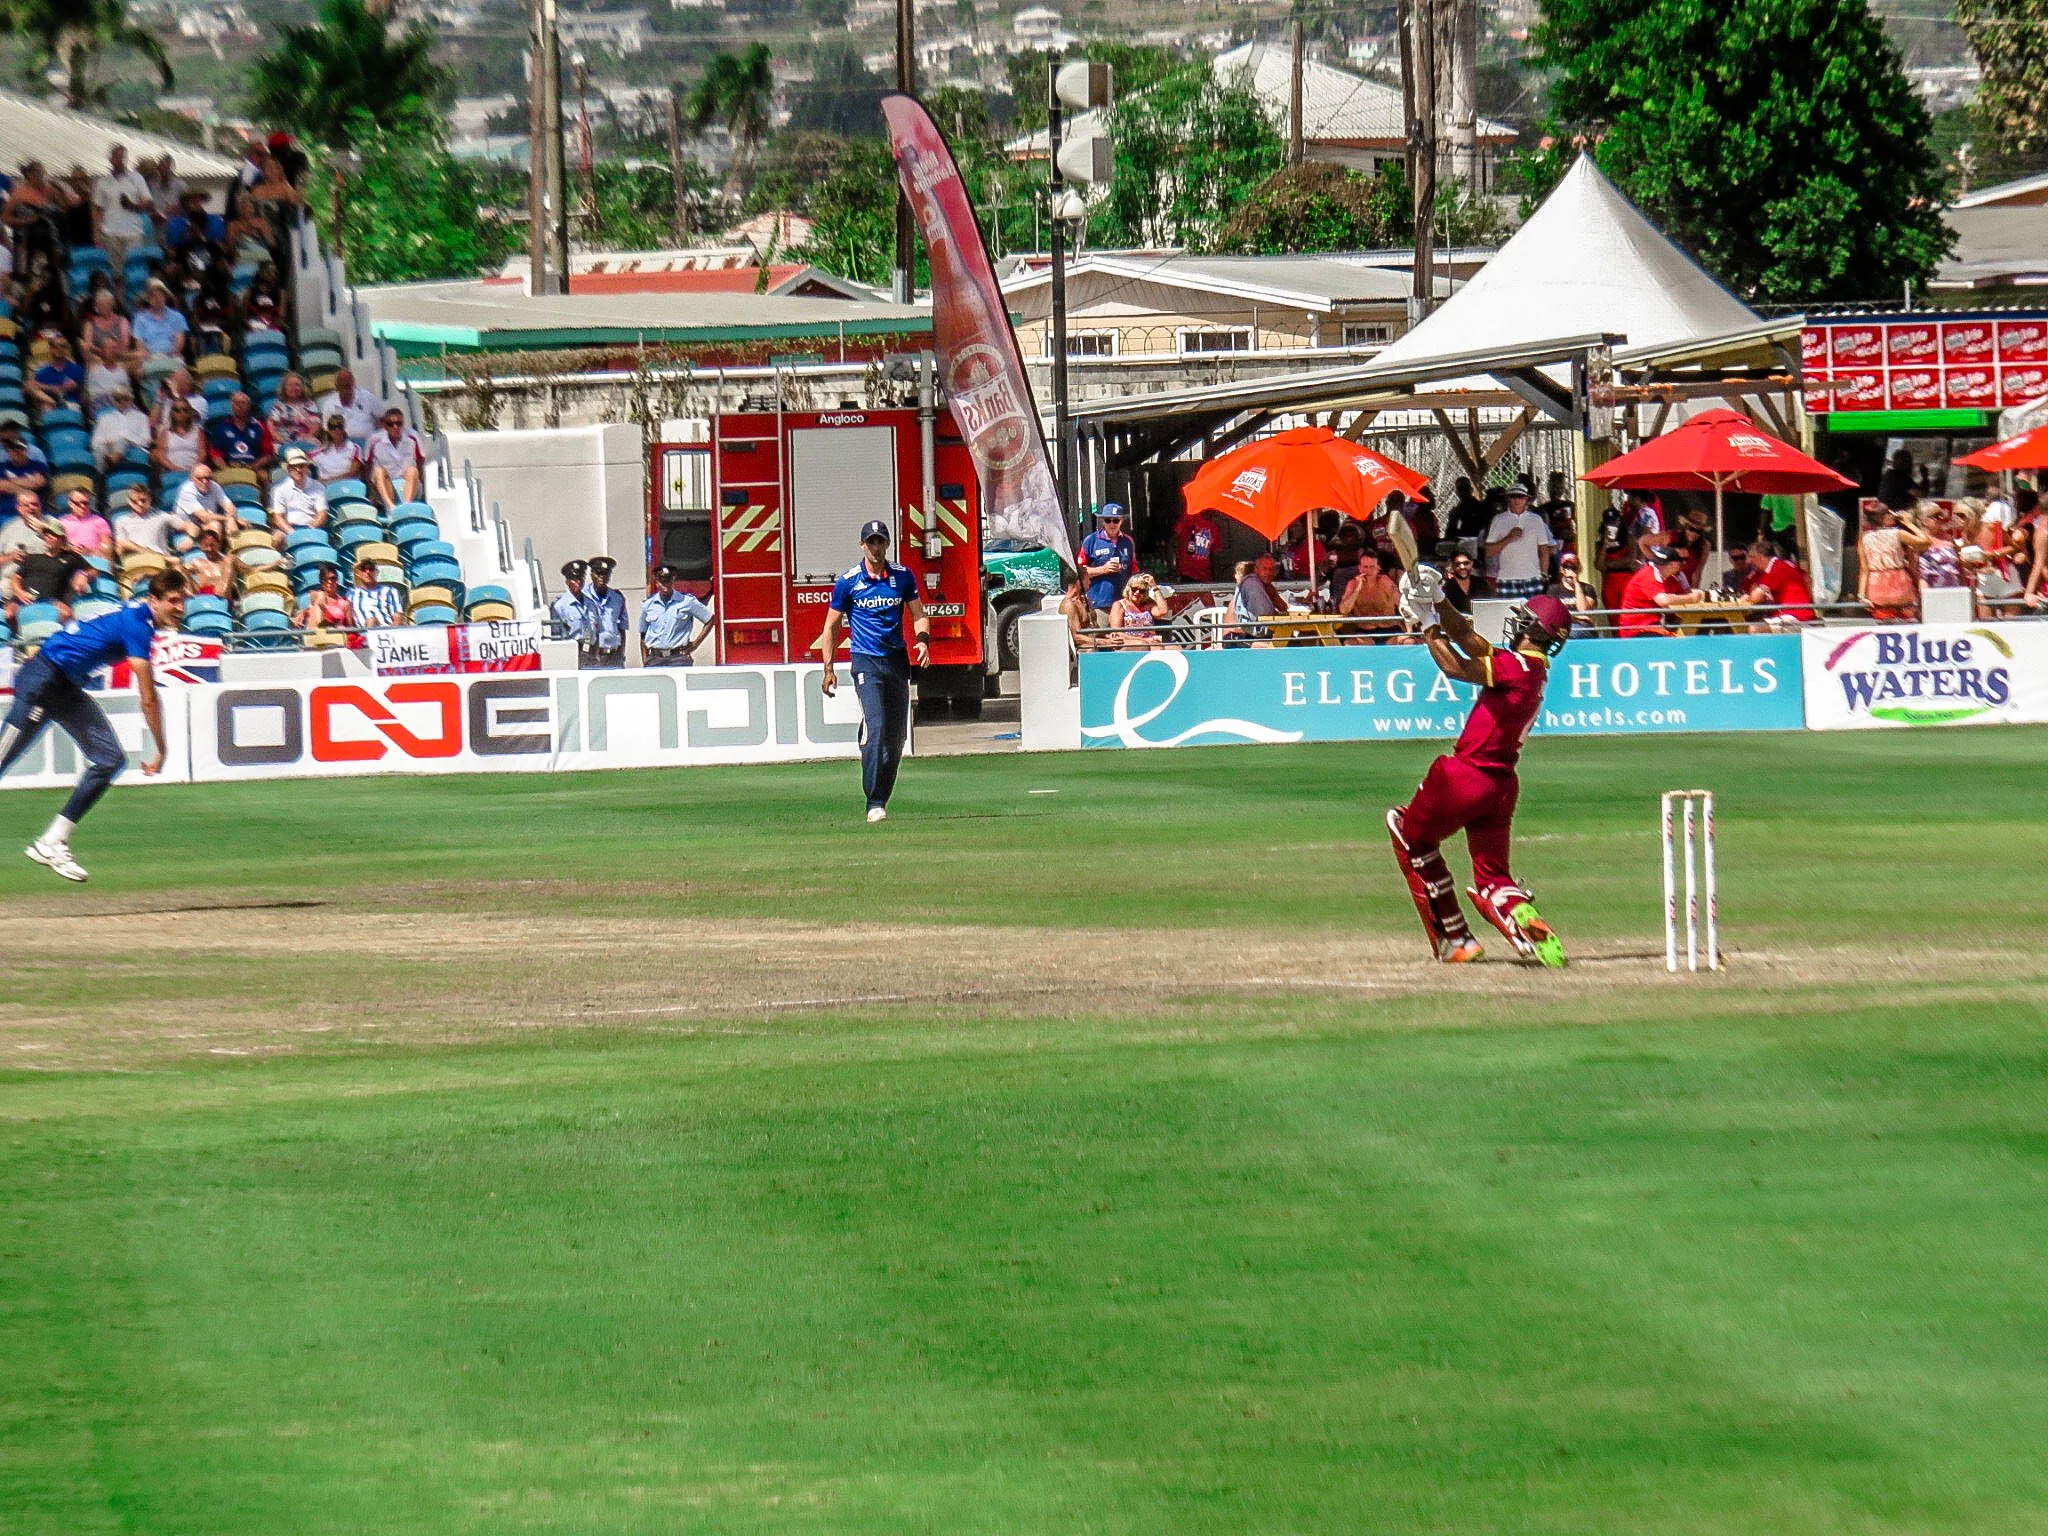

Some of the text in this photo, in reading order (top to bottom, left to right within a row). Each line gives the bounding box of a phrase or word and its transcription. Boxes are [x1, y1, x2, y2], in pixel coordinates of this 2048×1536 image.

[819, 413, 865, 426] Angloco
[377, 645, 430, 663] JAMIE
[1875, 631, 1973, 665] Blue
[1282, 668, 1480, 706] ELEGA
[1568, 657, 1779, 699] HOTELS
[1840, 667, 2011, 712] WATERS
